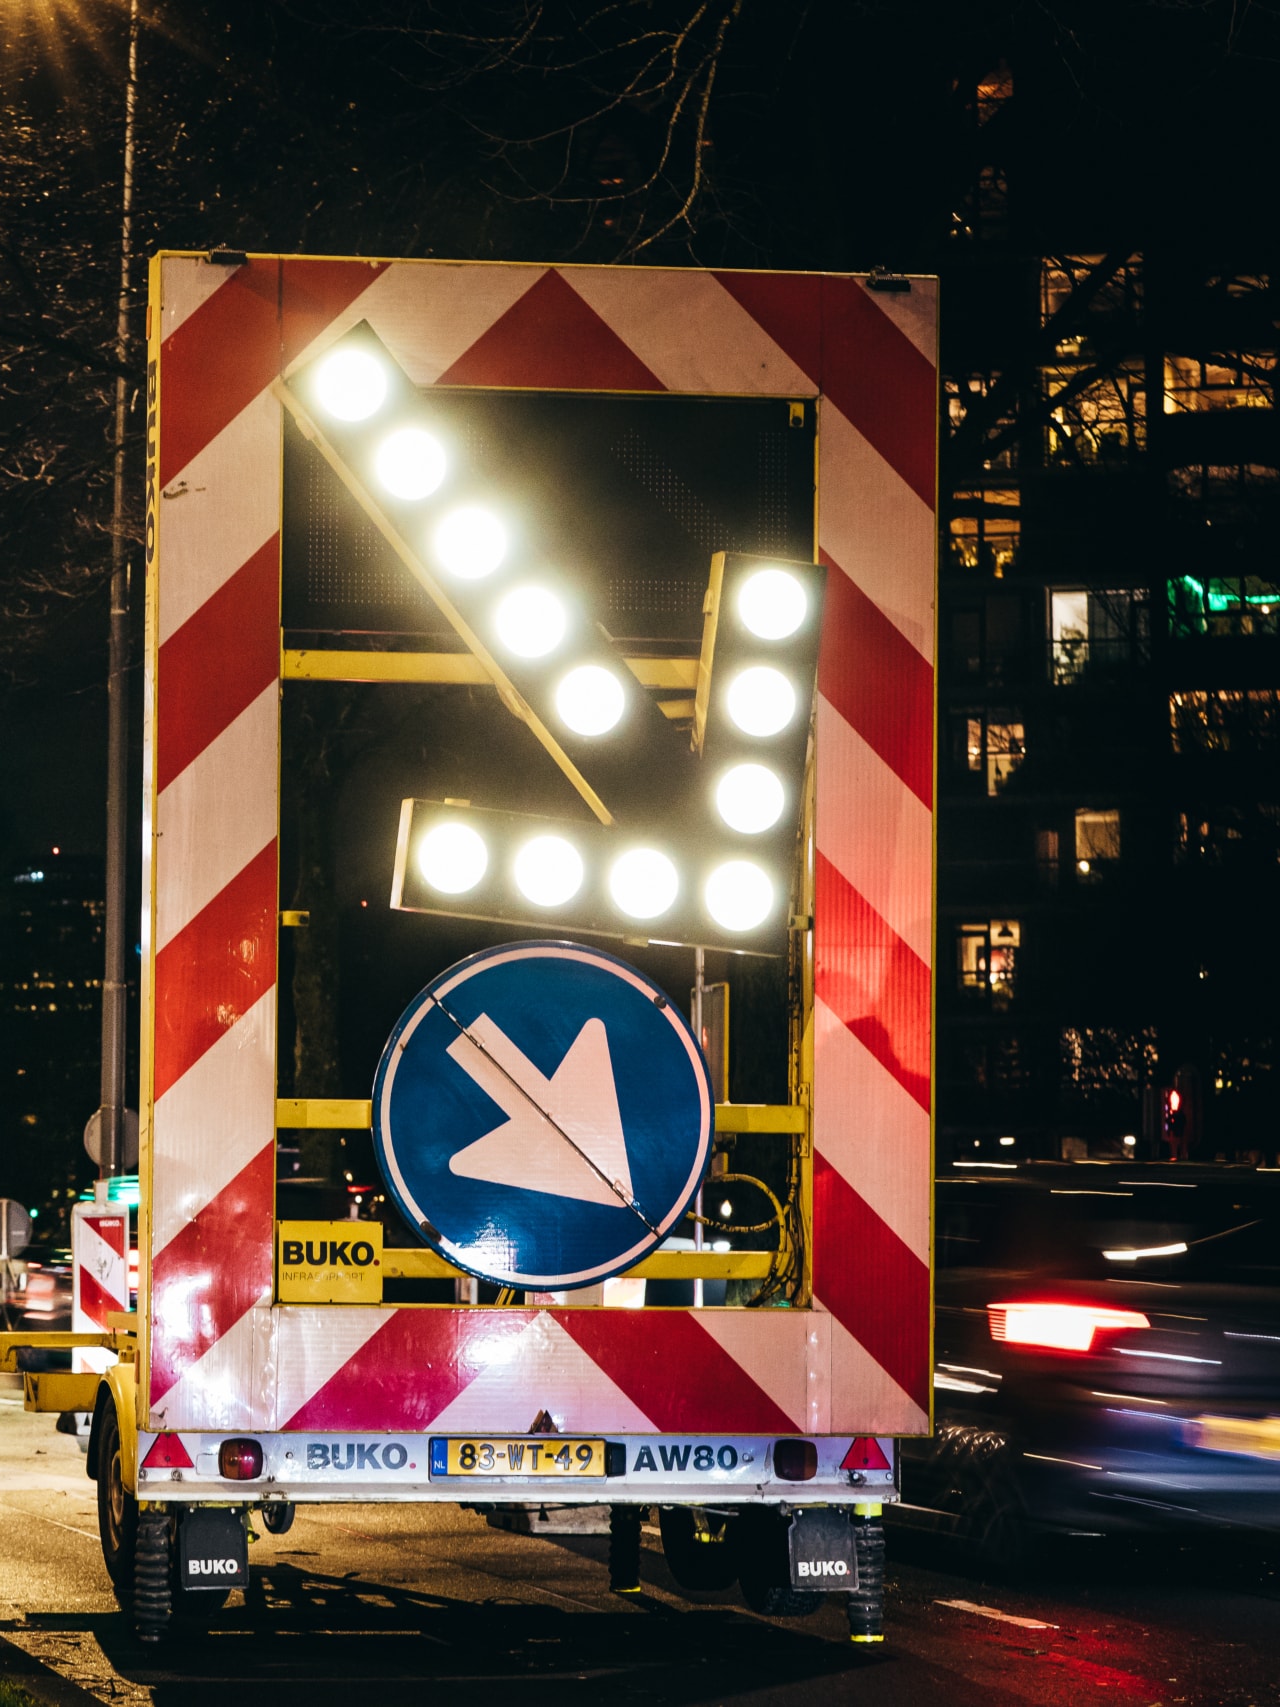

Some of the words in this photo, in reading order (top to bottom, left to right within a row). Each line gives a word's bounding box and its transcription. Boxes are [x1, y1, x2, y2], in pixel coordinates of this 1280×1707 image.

[282, 1241, 380, 1266] BUKO.
[306, 1443, 417, 1470] BUKO.
[434, 1461, 446, 1469] NL
[459, 1443, 594, 1471] 83-WT-49
[632, 1444, 739, 1472] AW80
[188, 1559, 241, 1575] BUKO.
[797, 1560, 851, 1577] BUKO.
